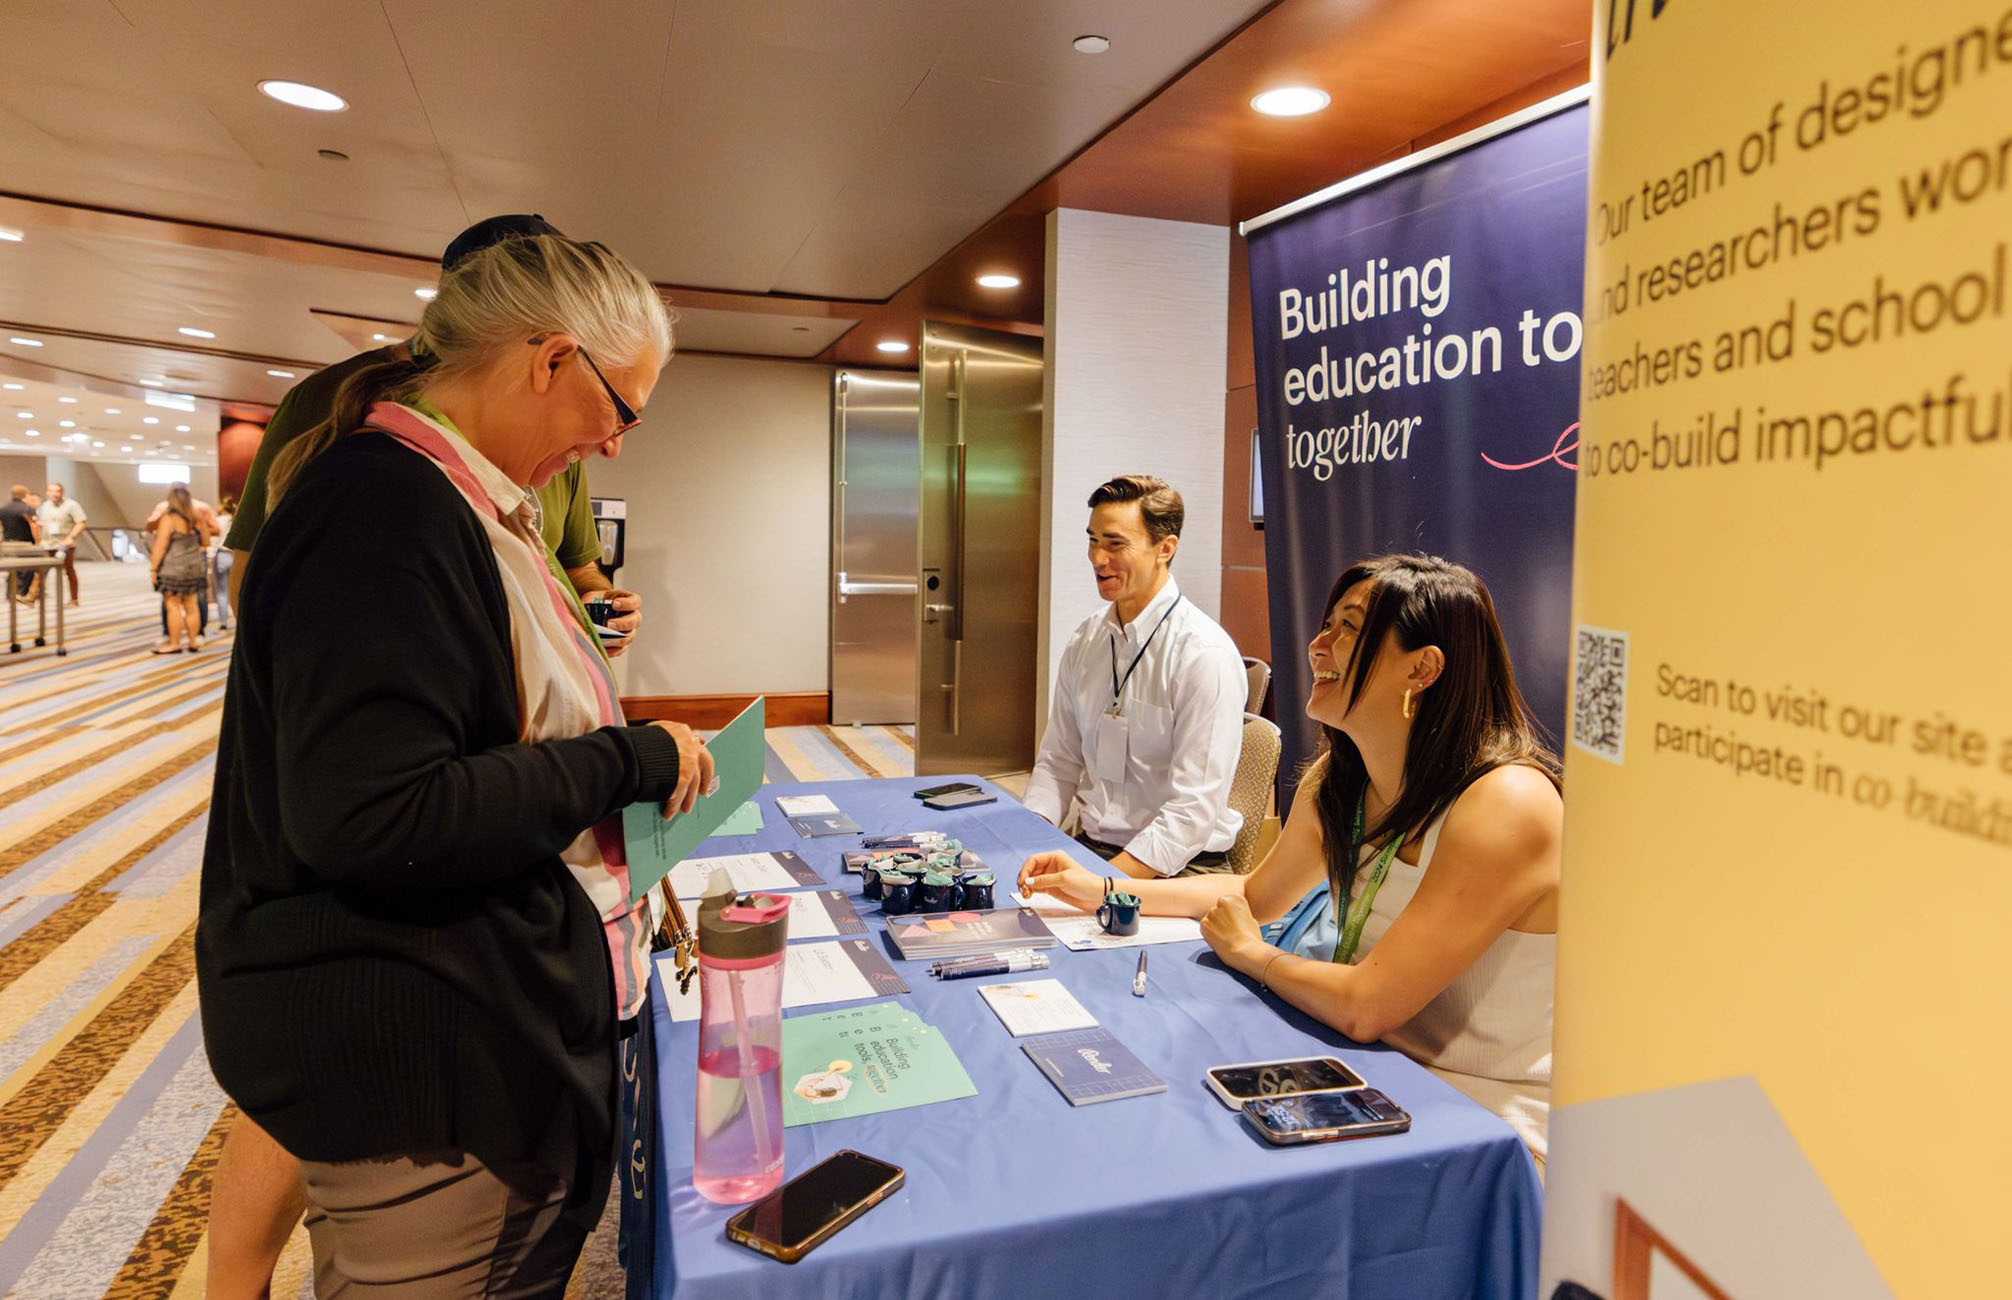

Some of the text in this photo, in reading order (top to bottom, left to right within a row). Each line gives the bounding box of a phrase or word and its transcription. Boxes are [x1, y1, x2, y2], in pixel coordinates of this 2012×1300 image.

[1641, 148, 1725, 222] team
[1738, 101, 1784, 177] of
[1599, 263, 1630, 321] nd
[1636, 184, 1881, 308] researchers
[1280, 255, 1451, 340] Building
[1713, 299, 1795, 373] and
[1810, 243, 2007, 354] school
[1284, 309, 1583, 406] education to
[1285, 410, 1422, 481] together
[1607, 407, 1742, 475] co-build
[1656, 662, 1719, 707] Scan
[1727, 681, 1756, 715] to
[1765, 684, 1830, 733] visit
[1839, 704, 1902, 746] our
[1912, 710, 1988, 768] site
[1655, 720, 1804, 786] participate
[1814, 752, 1844, 797] in
[870, 1041, 898, 1079] education
[886, 1038, 910, 1069] Building
